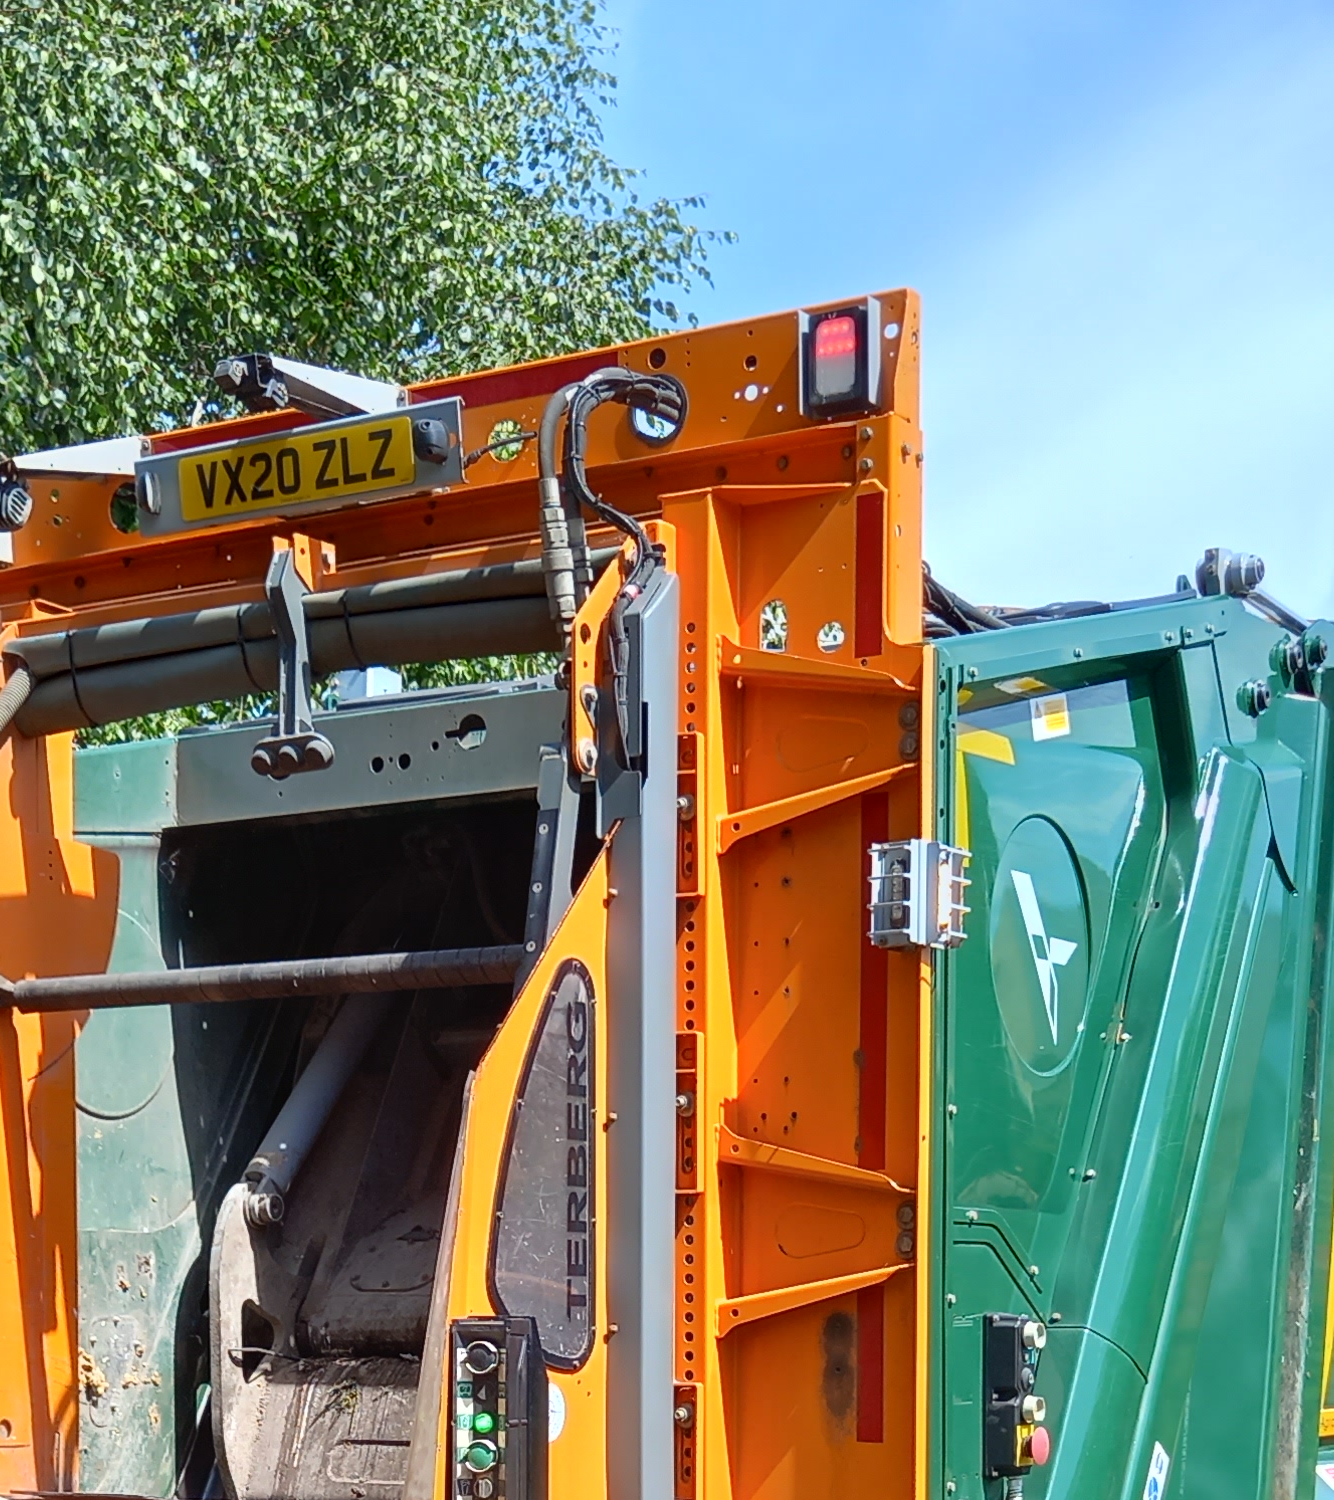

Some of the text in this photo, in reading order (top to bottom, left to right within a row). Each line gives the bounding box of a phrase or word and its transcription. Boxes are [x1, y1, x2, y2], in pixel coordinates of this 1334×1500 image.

[196, 428, 396, 509] VX20 ZLZ
[567, 1001, 587, 1322] TERBERG
